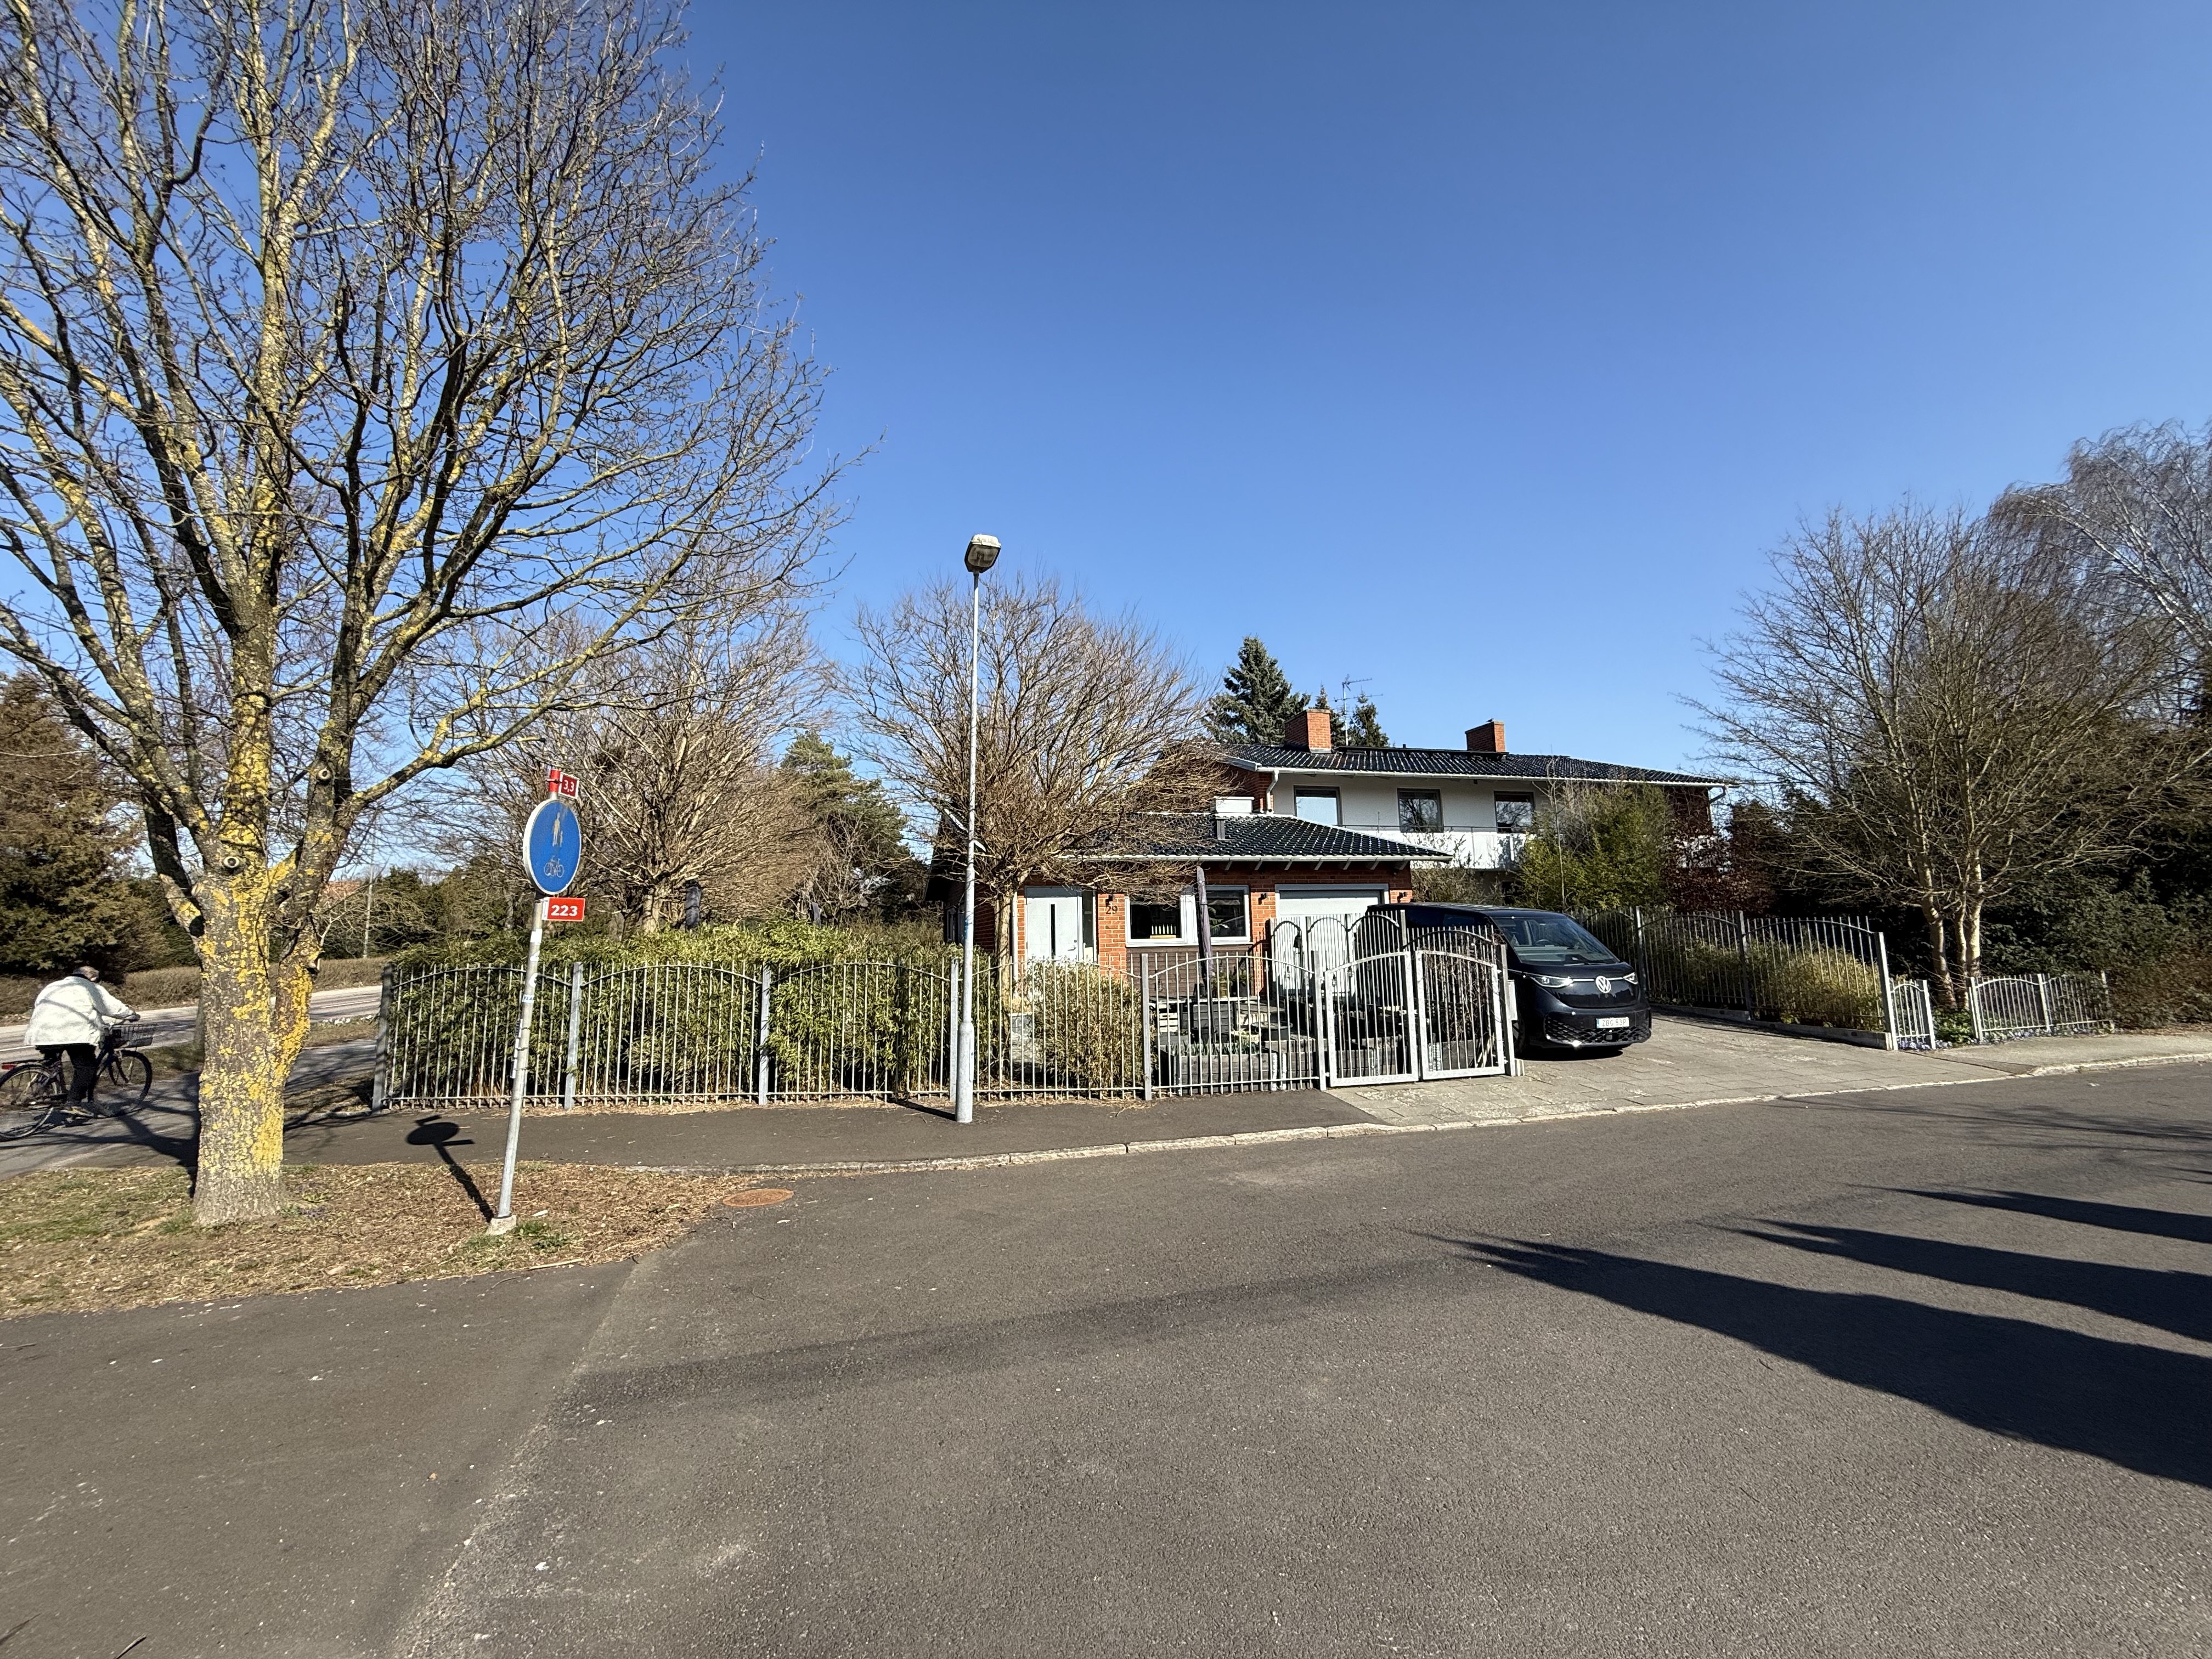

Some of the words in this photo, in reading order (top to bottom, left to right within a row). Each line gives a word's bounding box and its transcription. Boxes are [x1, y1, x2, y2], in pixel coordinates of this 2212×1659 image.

[563, 780, 574, 792] 3,3
[551, 905, 578, 917] 223
[1105, 905, 1118, 915] 29
